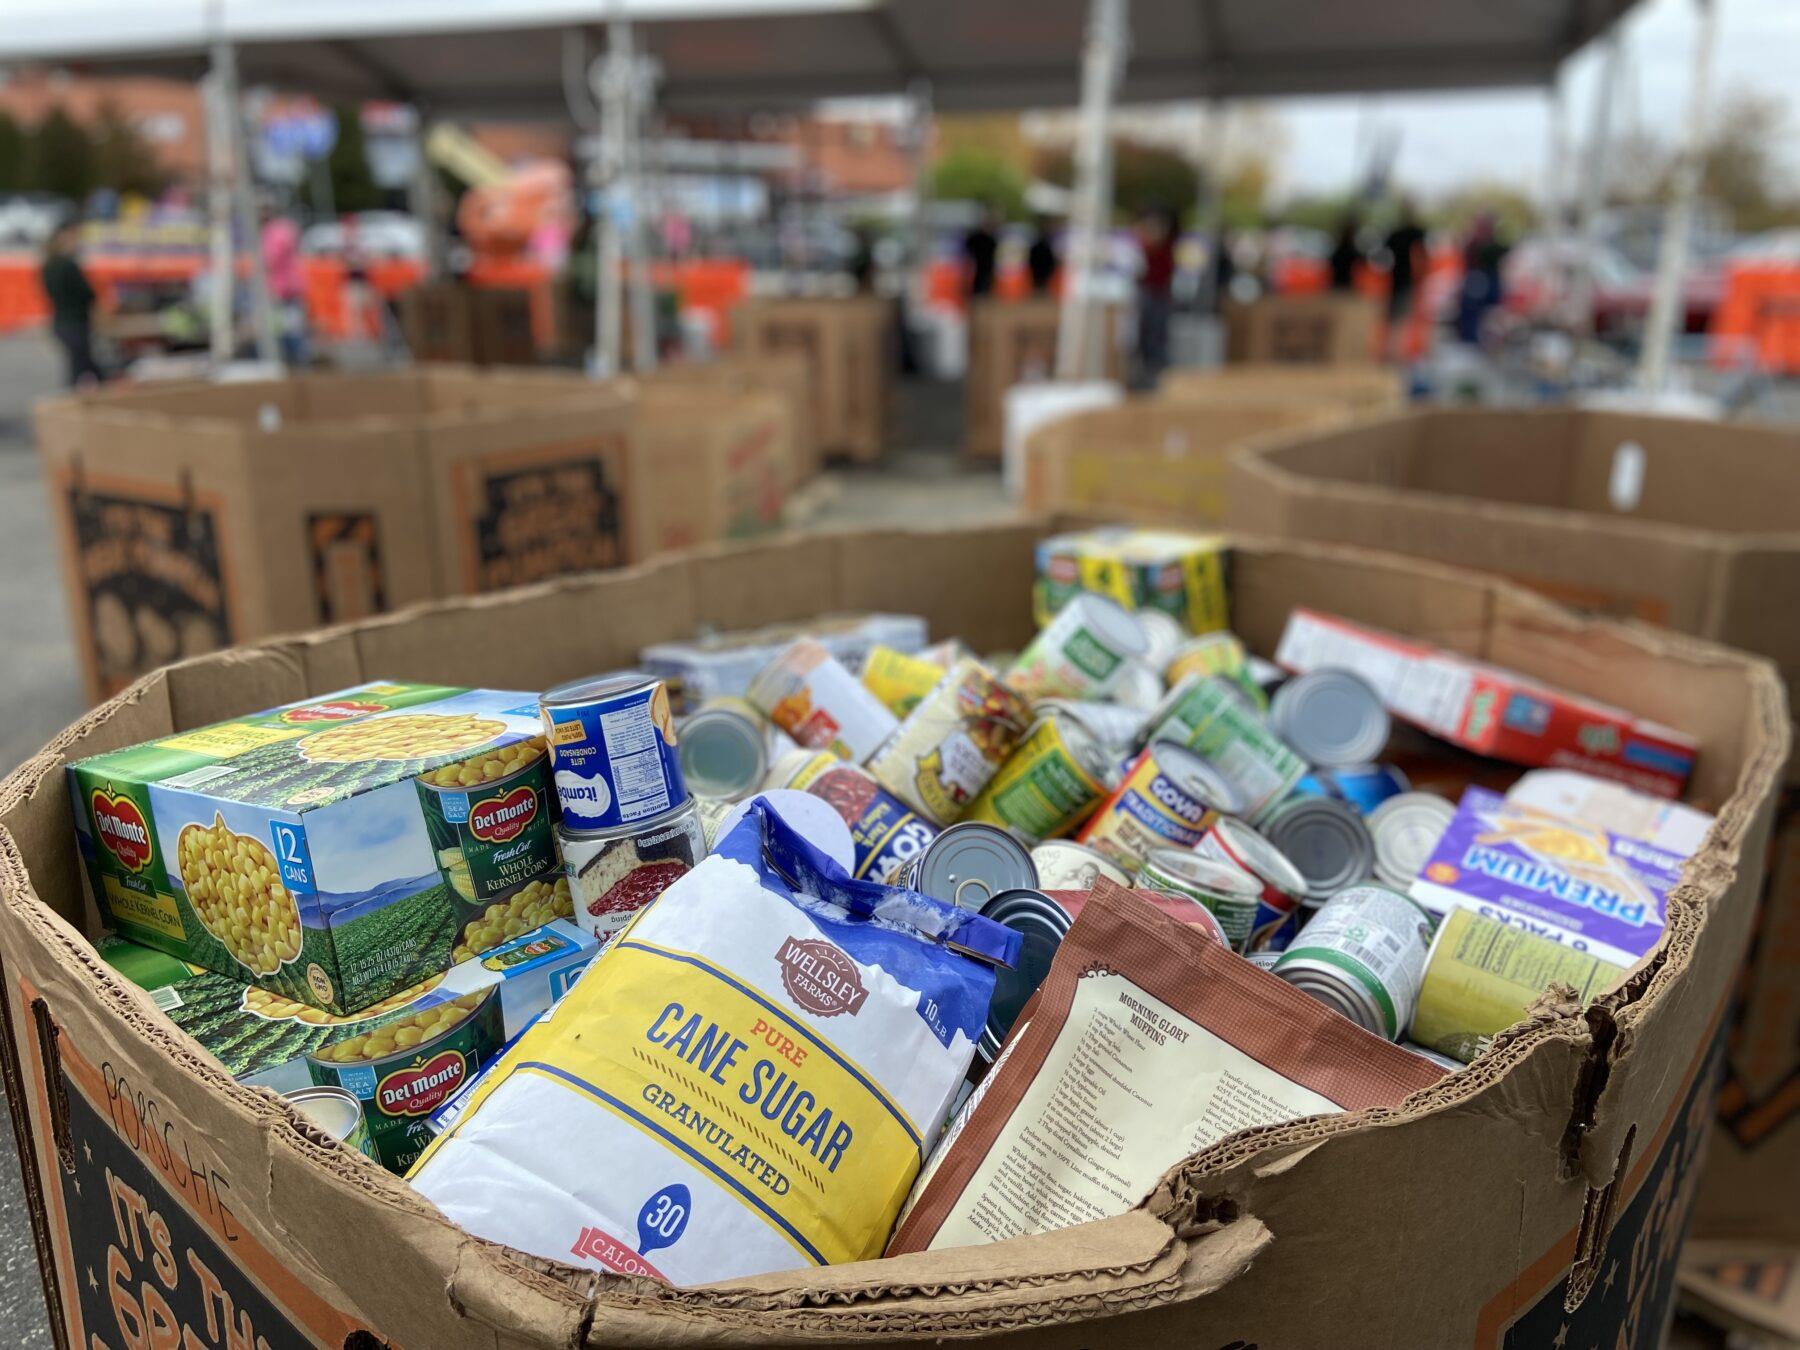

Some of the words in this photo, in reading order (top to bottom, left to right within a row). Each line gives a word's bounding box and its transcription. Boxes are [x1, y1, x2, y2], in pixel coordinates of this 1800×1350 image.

[474, 812, 494, 830] Del
[495, 797, 534, 823] Monte
[622, 810, 641, 819] Facts
[641, 801, 669, 814] Nutrition
[96, 810, 112, 834] Del
[111, 816, 146, 844] Monte
[278, 826, 303, 863] 12
[494, 821, 520, 836] Quality
[498, 854, 533, 876] WHOLE
[868, 822, 934, 882] GOY
[284, 866, 308, 884] CANS
[486, 873, 524, 891] KERNEL
[523, 856, 549, 878] CORN
[1464, 847, 1646, 925] PREMIUM
[610, 912, 634, 925] pping
[785, 943, 861, 1005] WELLSLEY
[924, 999, 937, 1022] 10
[935, 1020, 948, 1037] LB
[1119, 991, 1159, 1025] MORNING
[1158, 1018, 1190, 1044] GLORY
[1129, 1012, 1167, 1046] MUFFINS
[750, 1018, 810, 1069] PURE
[351, 1087, 373, 1095] ALT
[383, 1085, 411, 1105] Del
[411, 1062, 460, 1095] Monte
[409, 1090, 443, 1108] Quality
[645, 1001, 748, 1086] CANE
[738, 1058, 854, 1174] SUGAR
[375, 1118, 404, 1130] MADE
[641, 1083, 790, 1197] GRANULATED
[101, 1061, 239, 1242] PORSCHE
[646, 1194, 685, 1238] 30
[591, 1238, 653, 1278] CALOR
[187, 1247, 271, 1350] TH
